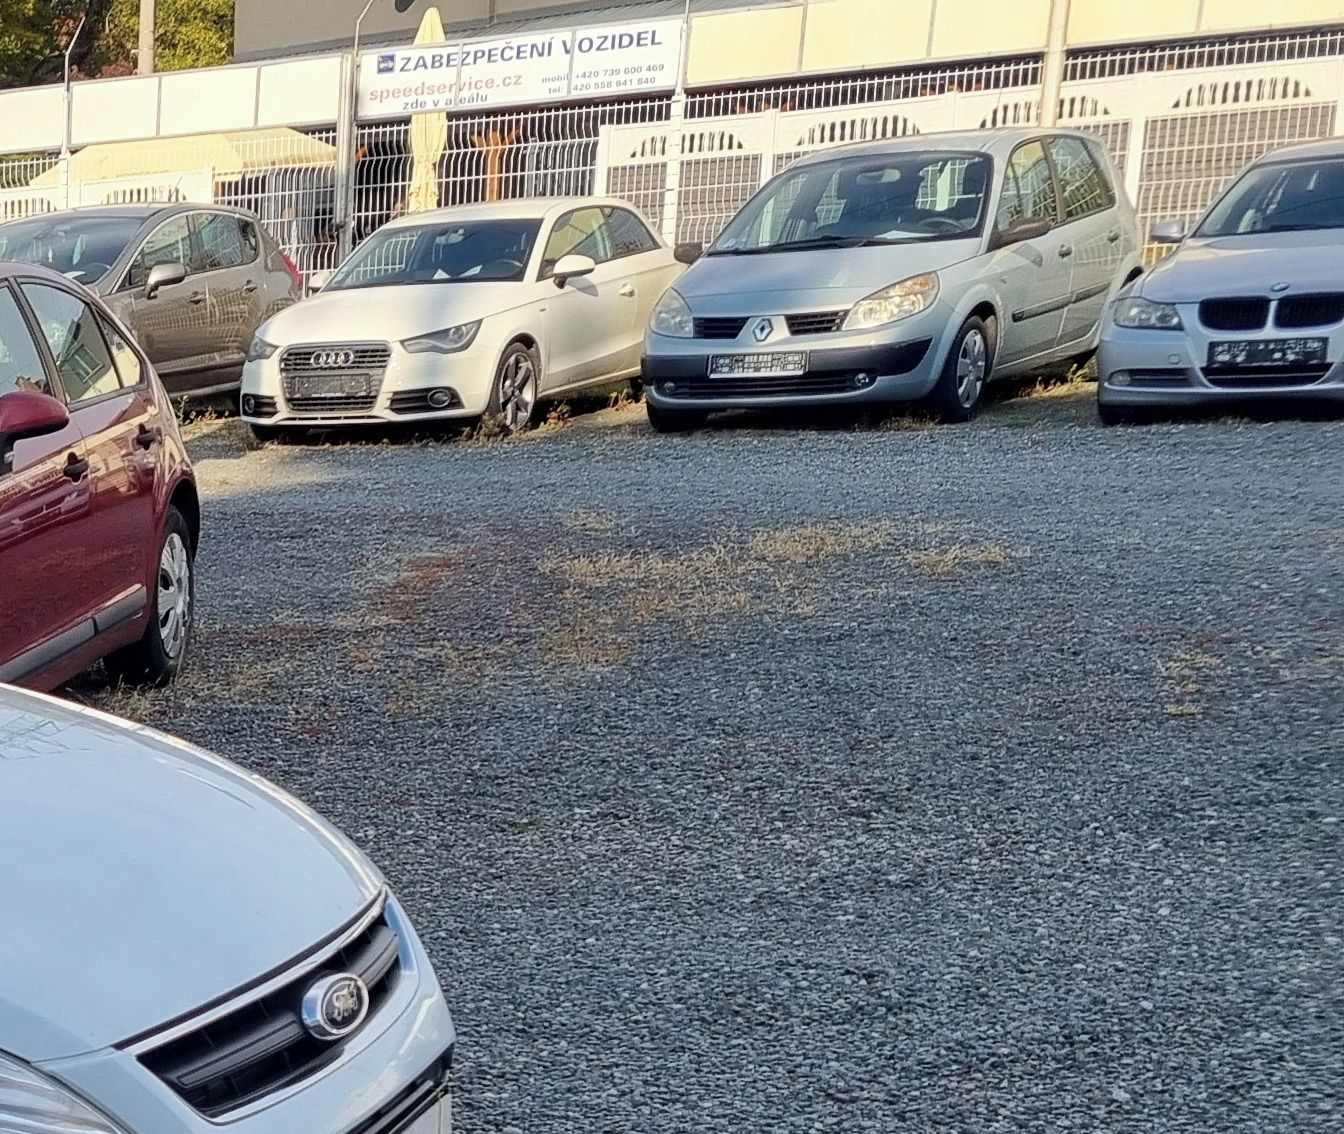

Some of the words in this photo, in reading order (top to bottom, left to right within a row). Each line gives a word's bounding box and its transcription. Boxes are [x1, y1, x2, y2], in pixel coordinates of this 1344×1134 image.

[399, 37, 555, 73] ZABEZPEČENÍ
[562, 29, 663, 55] VOZIDEL
[402, 98, 427, 111] zde
[432, 98, 440, 107] v
[444, 93, 488, 106] aeálu
